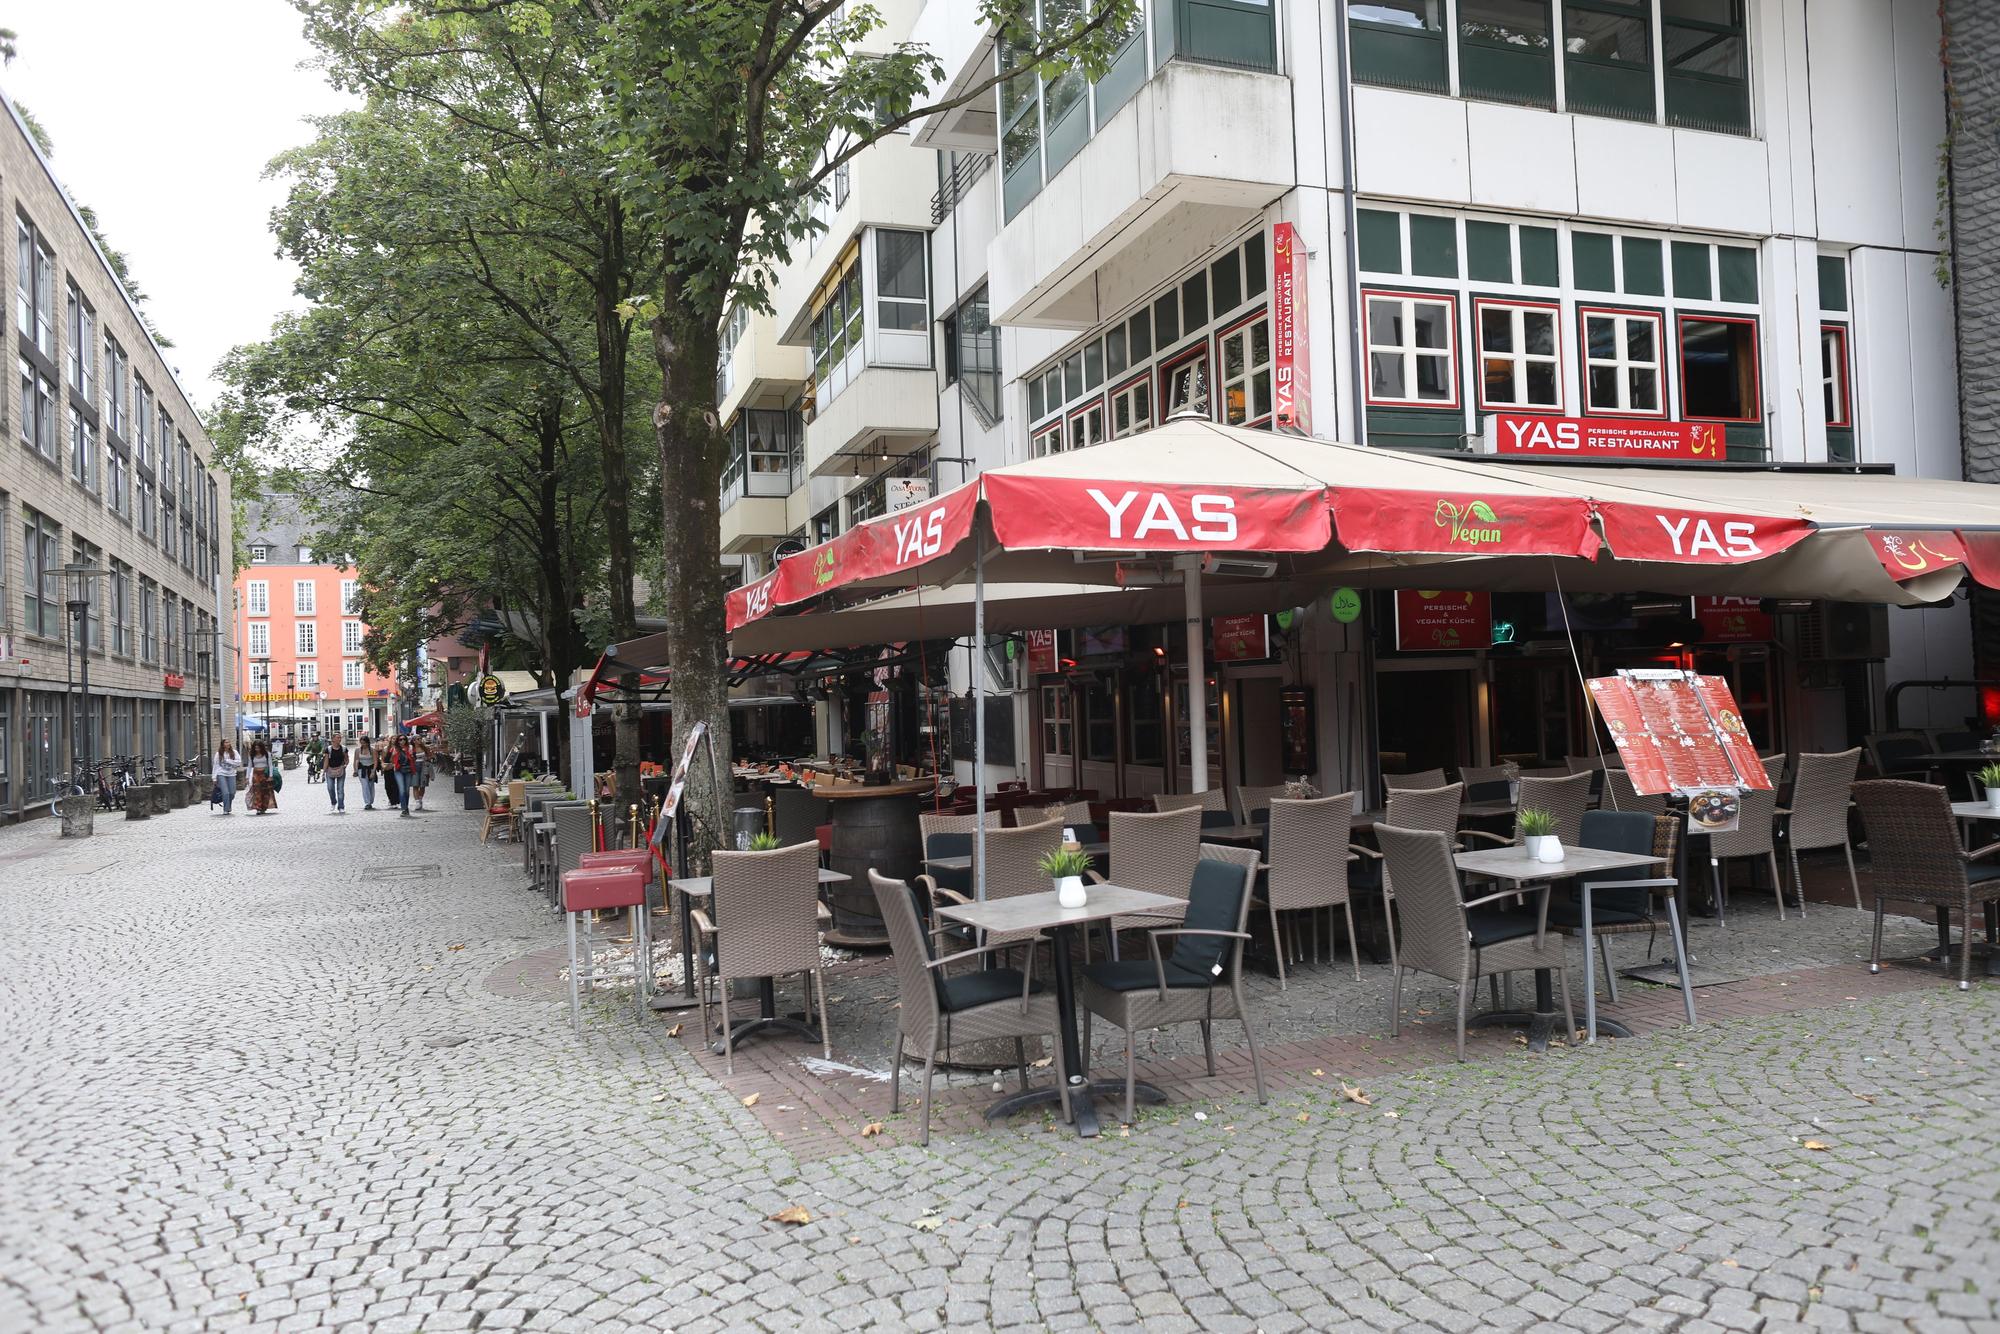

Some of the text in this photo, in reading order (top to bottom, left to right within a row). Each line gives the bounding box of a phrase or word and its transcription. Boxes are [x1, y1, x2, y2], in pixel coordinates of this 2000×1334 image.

[1283, 272, 1292, 356] RESTAURANT
[1278, 367, 1292, 413] YAS
[1505, 420, 1580, 450] YAS
[1587, 438, 1680, 450] RESTAURANT
[1629, 429, 1680, 437] SPEZIALITÄTEN
[893, 507, 946, 565] YAS
[1085, 488, 1238, 542] YAS
[1434, 499, 1502, 546] Vegan
[1655, 514, 1763, 558] YAS
[745, 580, 772, 620] YAS
[1030, 629, 1052, 647] YAS
